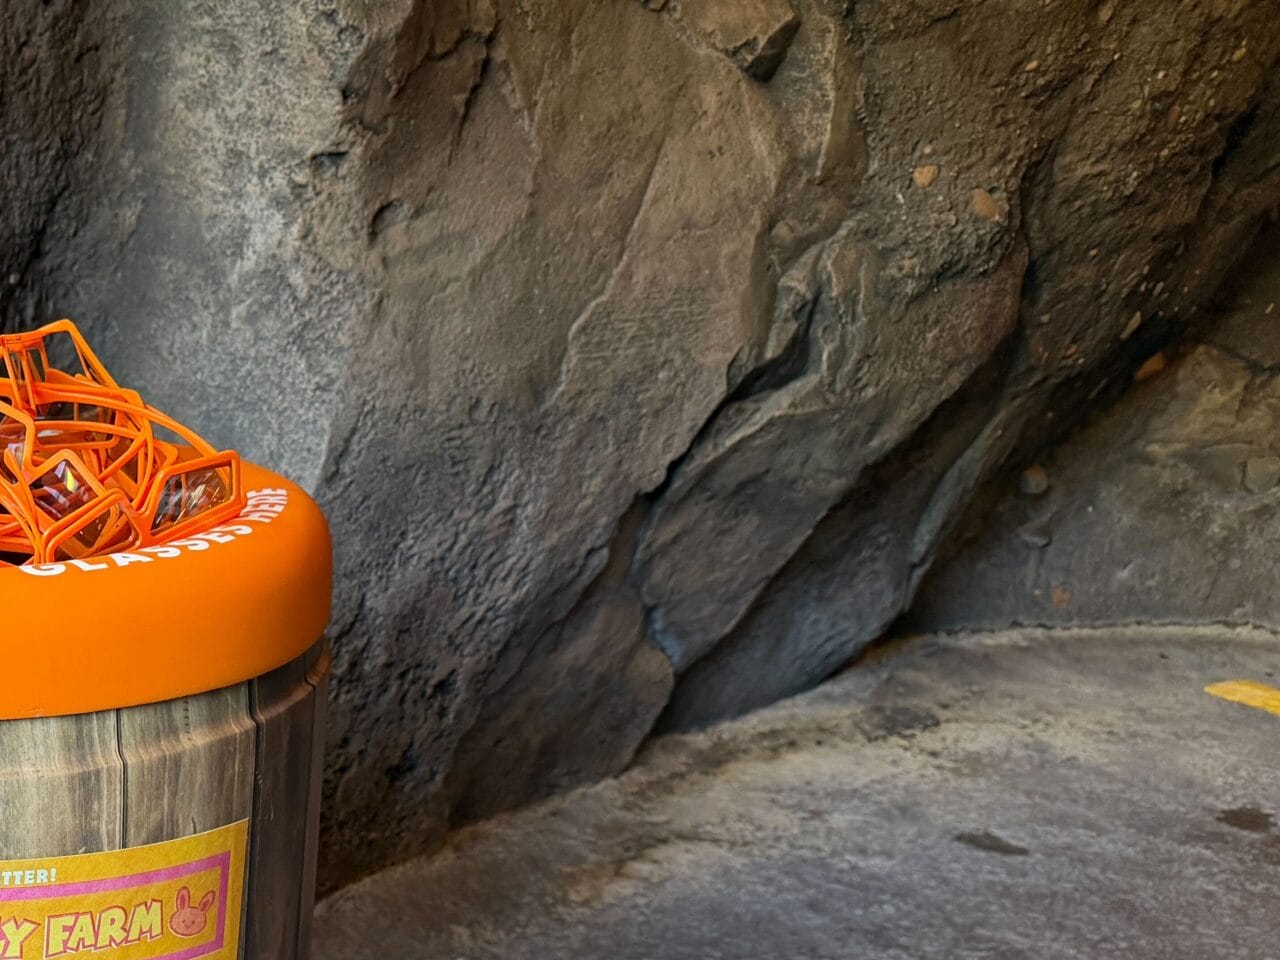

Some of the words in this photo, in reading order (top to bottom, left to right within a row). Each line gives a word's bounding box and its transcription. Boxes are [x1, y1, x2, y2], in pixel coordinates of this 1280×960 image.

[19, 524, 253, 576] GLASSES
[232, 488, 288, 523] HERE
[44, 898, 164, 959] FARM
